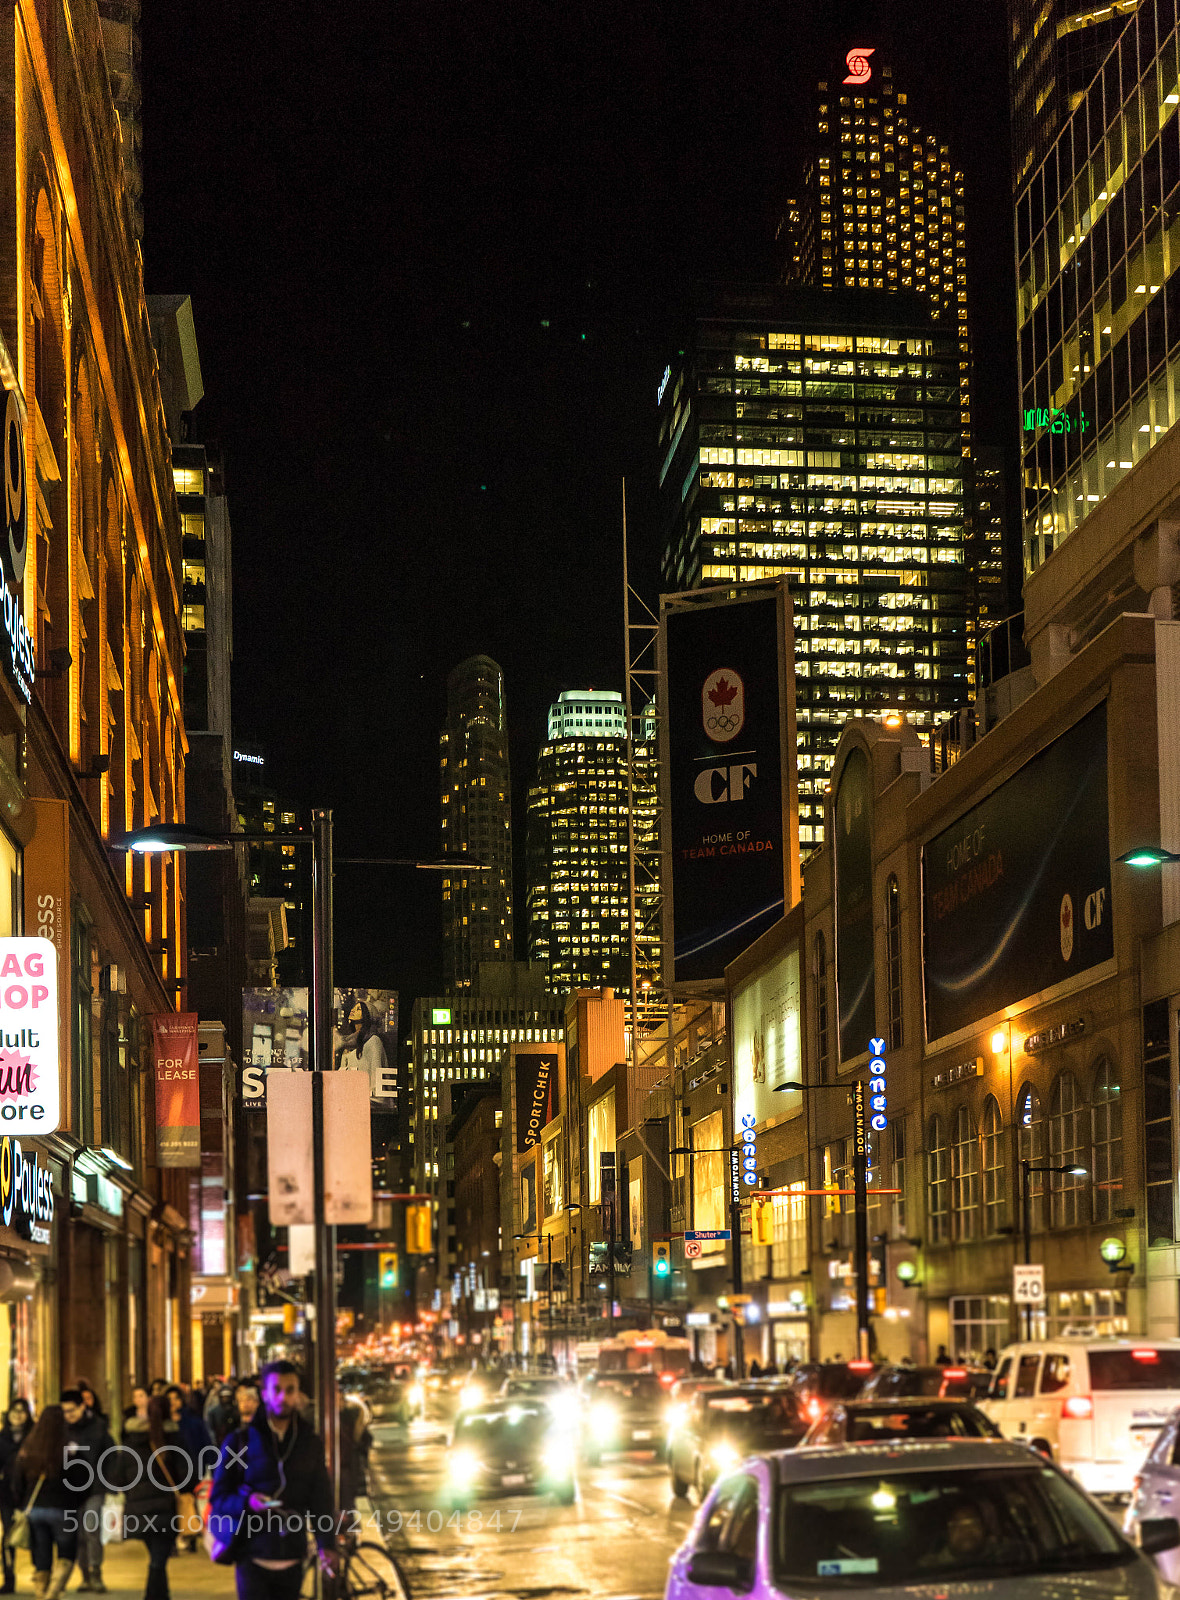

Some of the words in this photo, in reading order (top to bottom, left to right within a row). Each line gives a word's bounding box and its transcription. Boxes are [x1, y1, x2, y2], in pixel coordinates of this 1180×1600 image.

[0, 556, 35, 684] ayless
[233, 750, 265, 765] Dynamic
[693, 763, 758, 804] CF
[682, 846, 716, 859] TEAM
[719, 840, 774, 856] CANADA
[702, 832, 733, 844] HOME
[736, 830, 751, 841] OF
[1084, 887, 1106, 931] CF
[0, 952, 44, 978] AG
[0, 984, 49, 1009] OP
[0, 1057, 37, 1095] un
[157, 1058, 183, 1069] FOR
[157, 1070, 197, 1081] LEASE
[524, 1060, 551, 1146] SPORTCHEK
[868, 1037, 888, 1131] Yonge
[855, 1080, 864, 1153] DOWNTOWN
[741, 1114, 757, 1186] Yonge
[14, 1139, 54, 1233] Payless
[731, 1150, 740, 1203] DOWNTOWN
[694, 1231, 717, 1239] Shuter
[1017, 1280, 1042, 1298] 40
